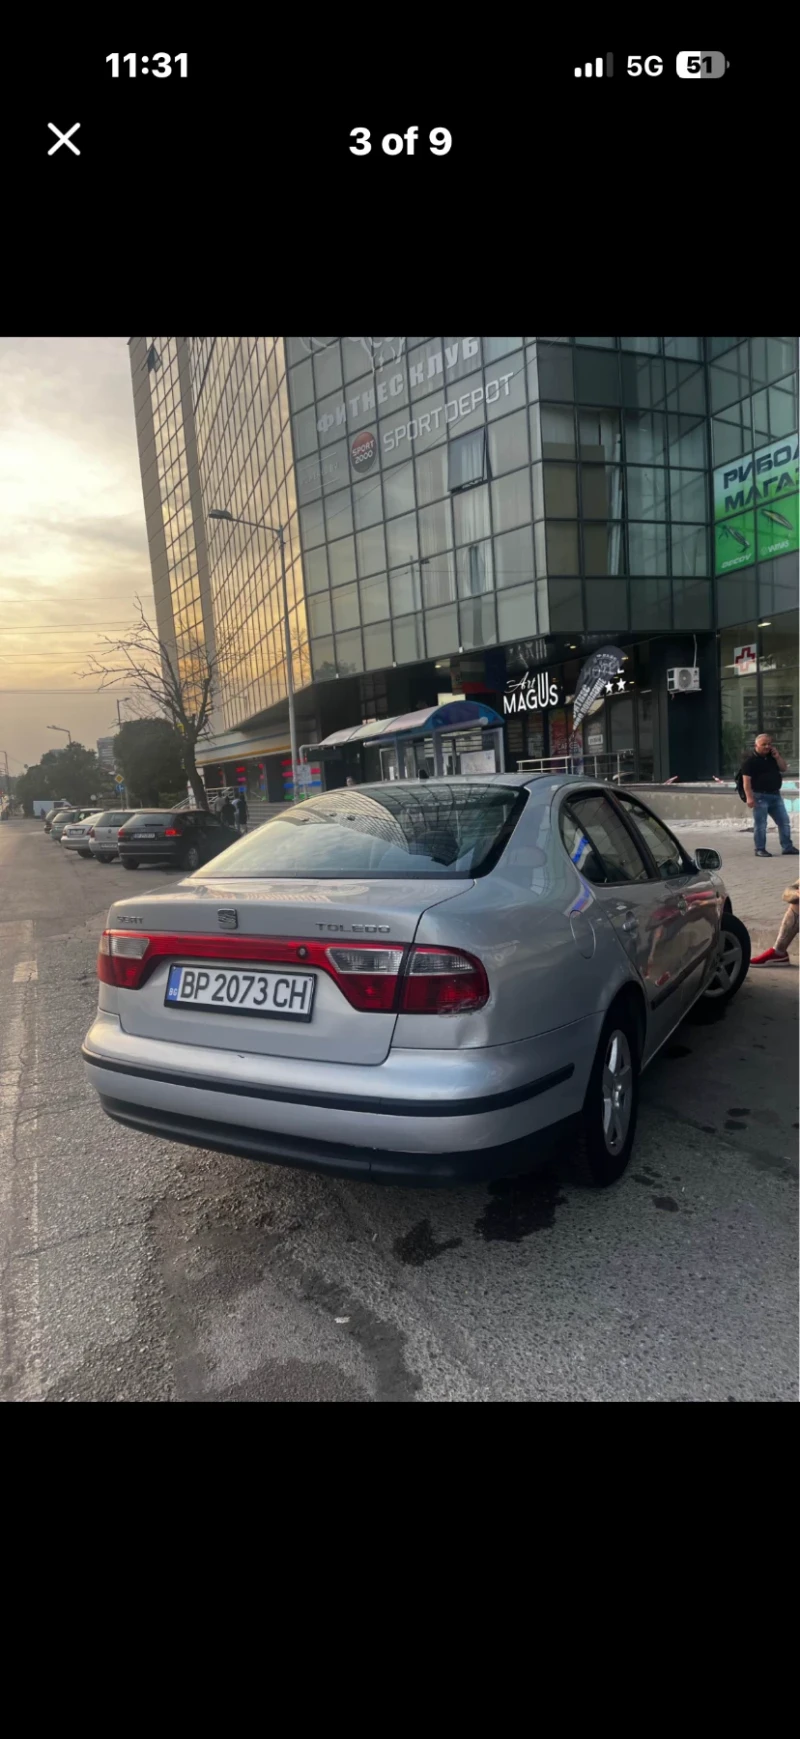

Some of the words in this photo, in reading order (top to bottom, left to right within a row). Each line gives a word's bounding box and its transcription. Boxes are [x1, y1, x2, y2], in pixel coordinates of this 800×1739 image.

[316, 373, 405, 433] ФИТНЕС
[410, 336, 479, 388] КЛУБ
[352, 440, 375, 457] SPORT
[354, 449, 374, 464] 2000
[504, 671, 536, 694] Art
[503, 672, 559, 714] MAGUS
[315, 921, 391, 934] TOLEDO
[169, 988, 178, 996] BG
[180, 971, 211, 1000] BP
[211, 973, 268, 1006] 2073
[272, 978, 309, 1010] CH
